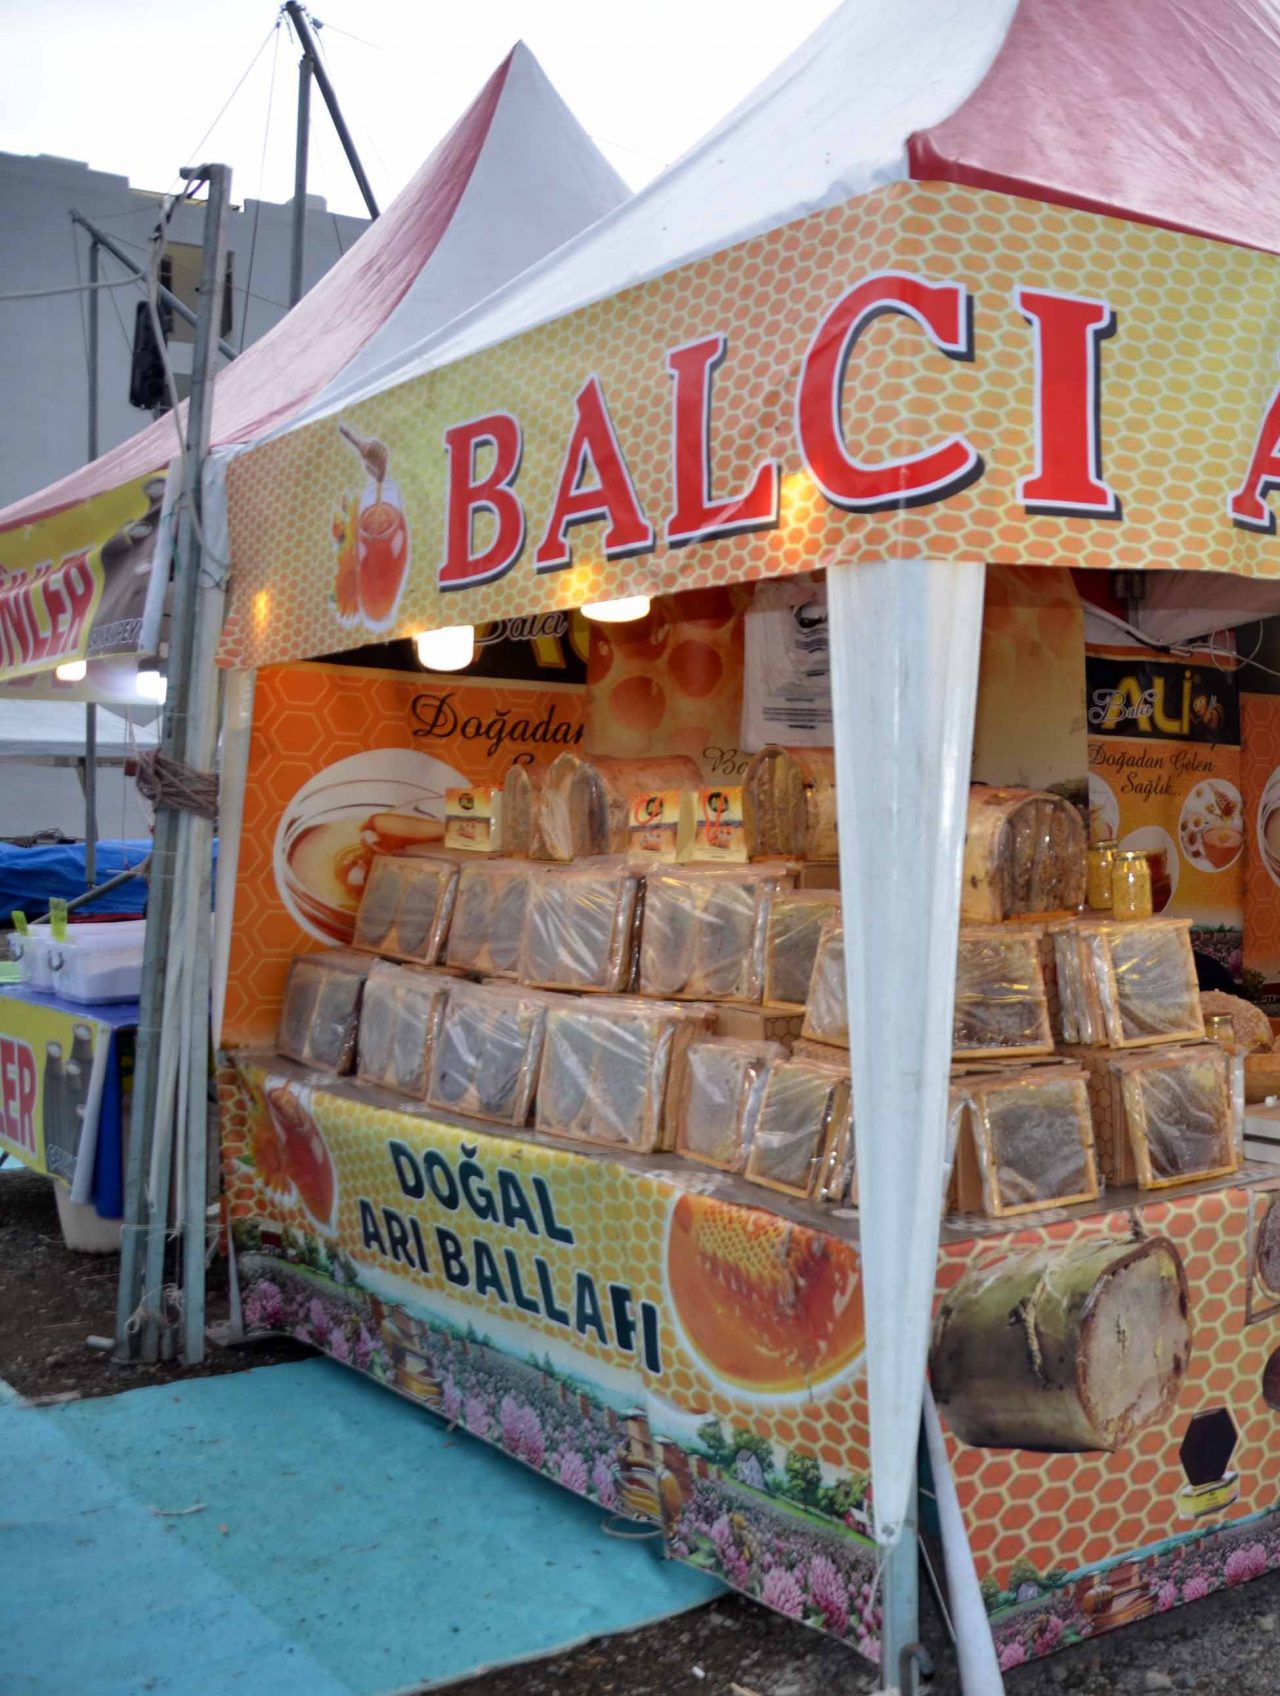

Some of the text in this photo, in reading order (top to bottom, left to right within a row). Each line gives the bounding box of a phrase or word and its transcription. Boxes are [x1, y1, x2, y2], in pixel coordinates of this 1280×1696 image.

[437, 268, 1123, 592] BALCI
[1087, 743, 1216, 777] Doğadan Gelen
[358, 1197, 430, 1273] ARI
[388, 1140, 575, 1245] DOĞAL
